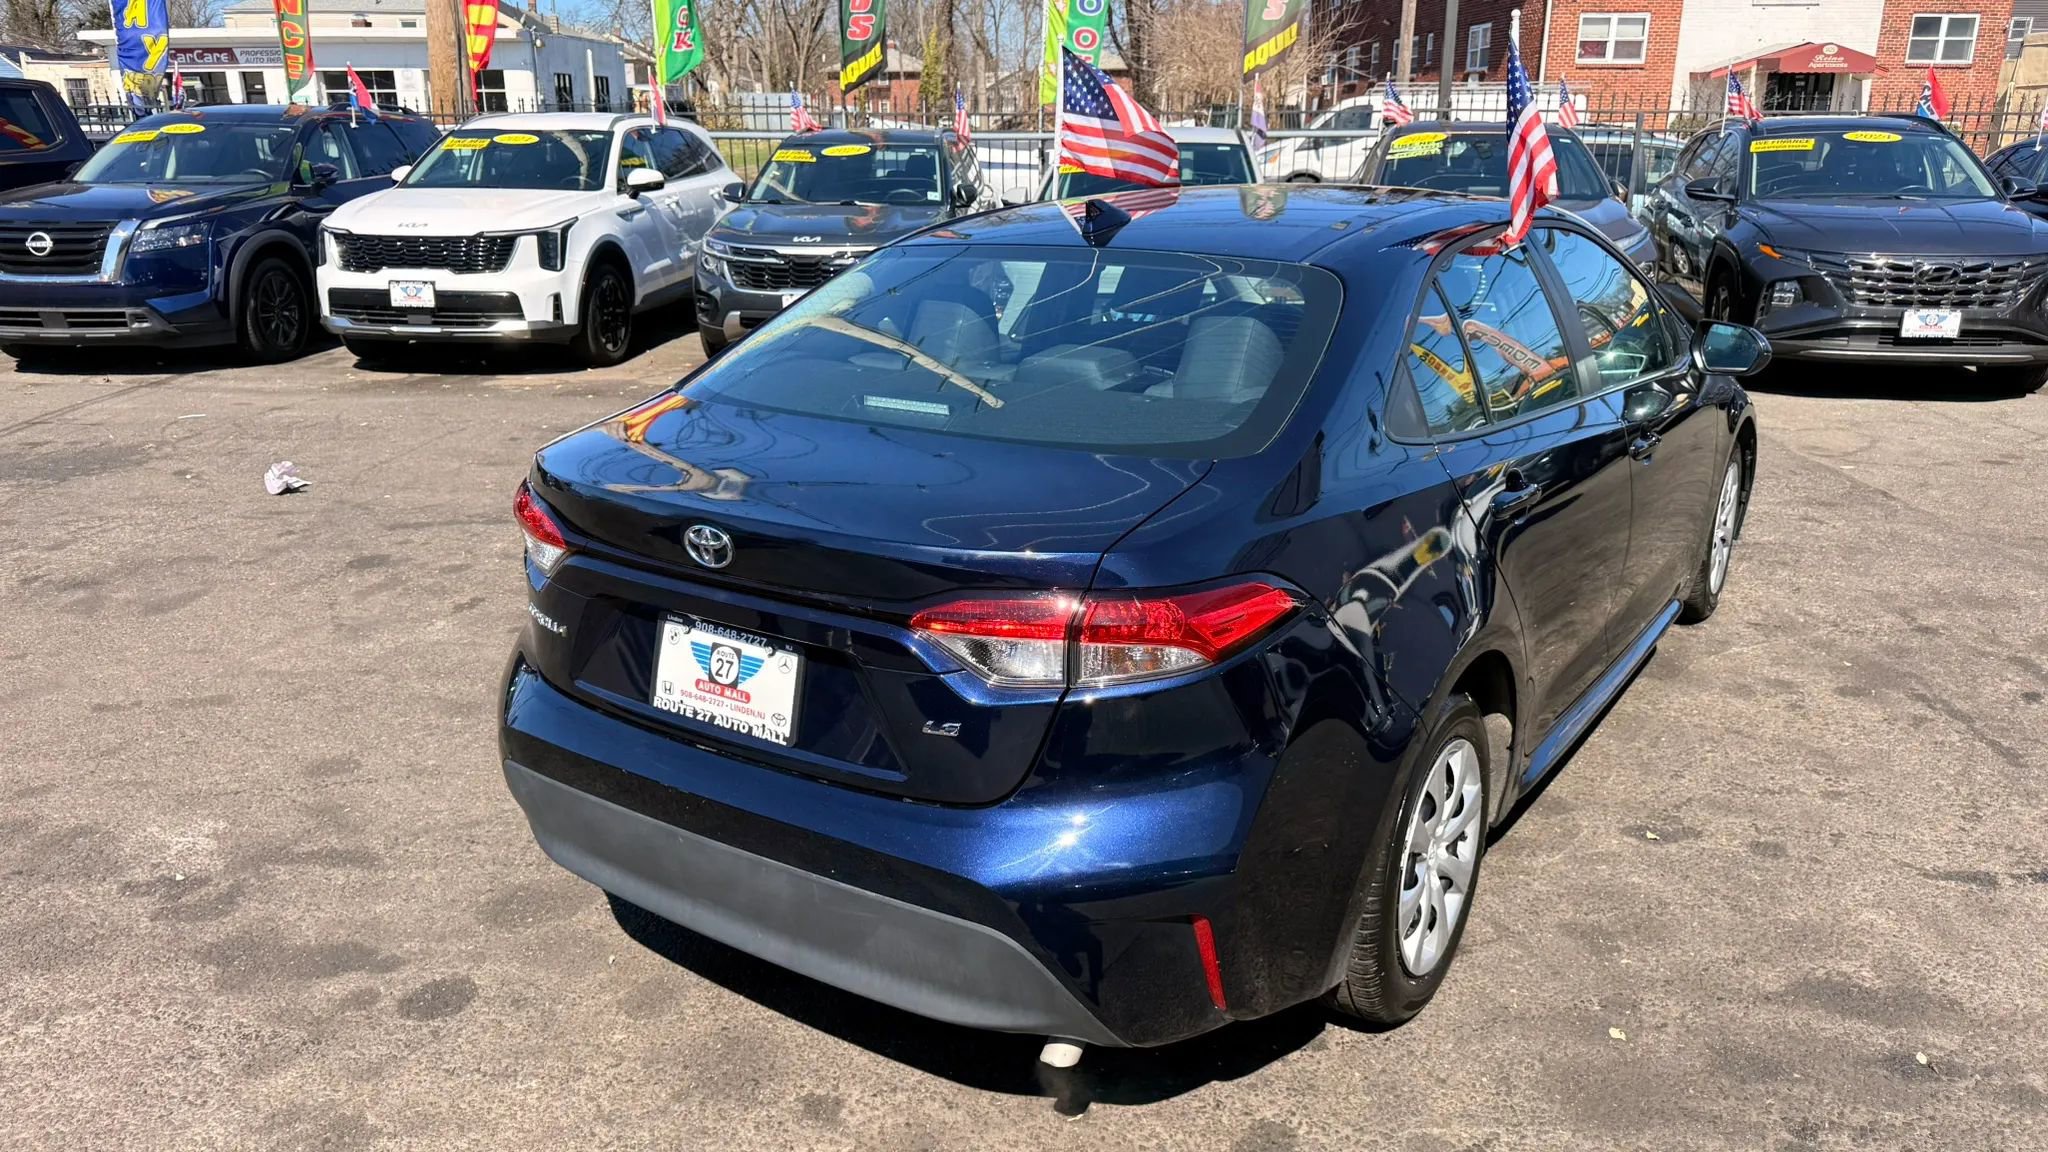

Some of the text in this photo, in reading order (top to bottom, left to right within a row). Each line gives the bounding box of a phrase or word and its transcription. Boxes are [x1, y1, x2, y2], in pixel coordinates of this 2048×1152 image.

[168, 50, 229, 63] CarCare
[695, 621, 767, 648] 908-648-2727
[716, 649, 735, 660] ROUTE
[715, 658, 734, 679] 27
[680, 689, 724, 707] 908-648-2727
[698, 680, 747, 702] AUTO MALL
[653, 695, 787, 746] ROUTE 27 AUTO MALL
